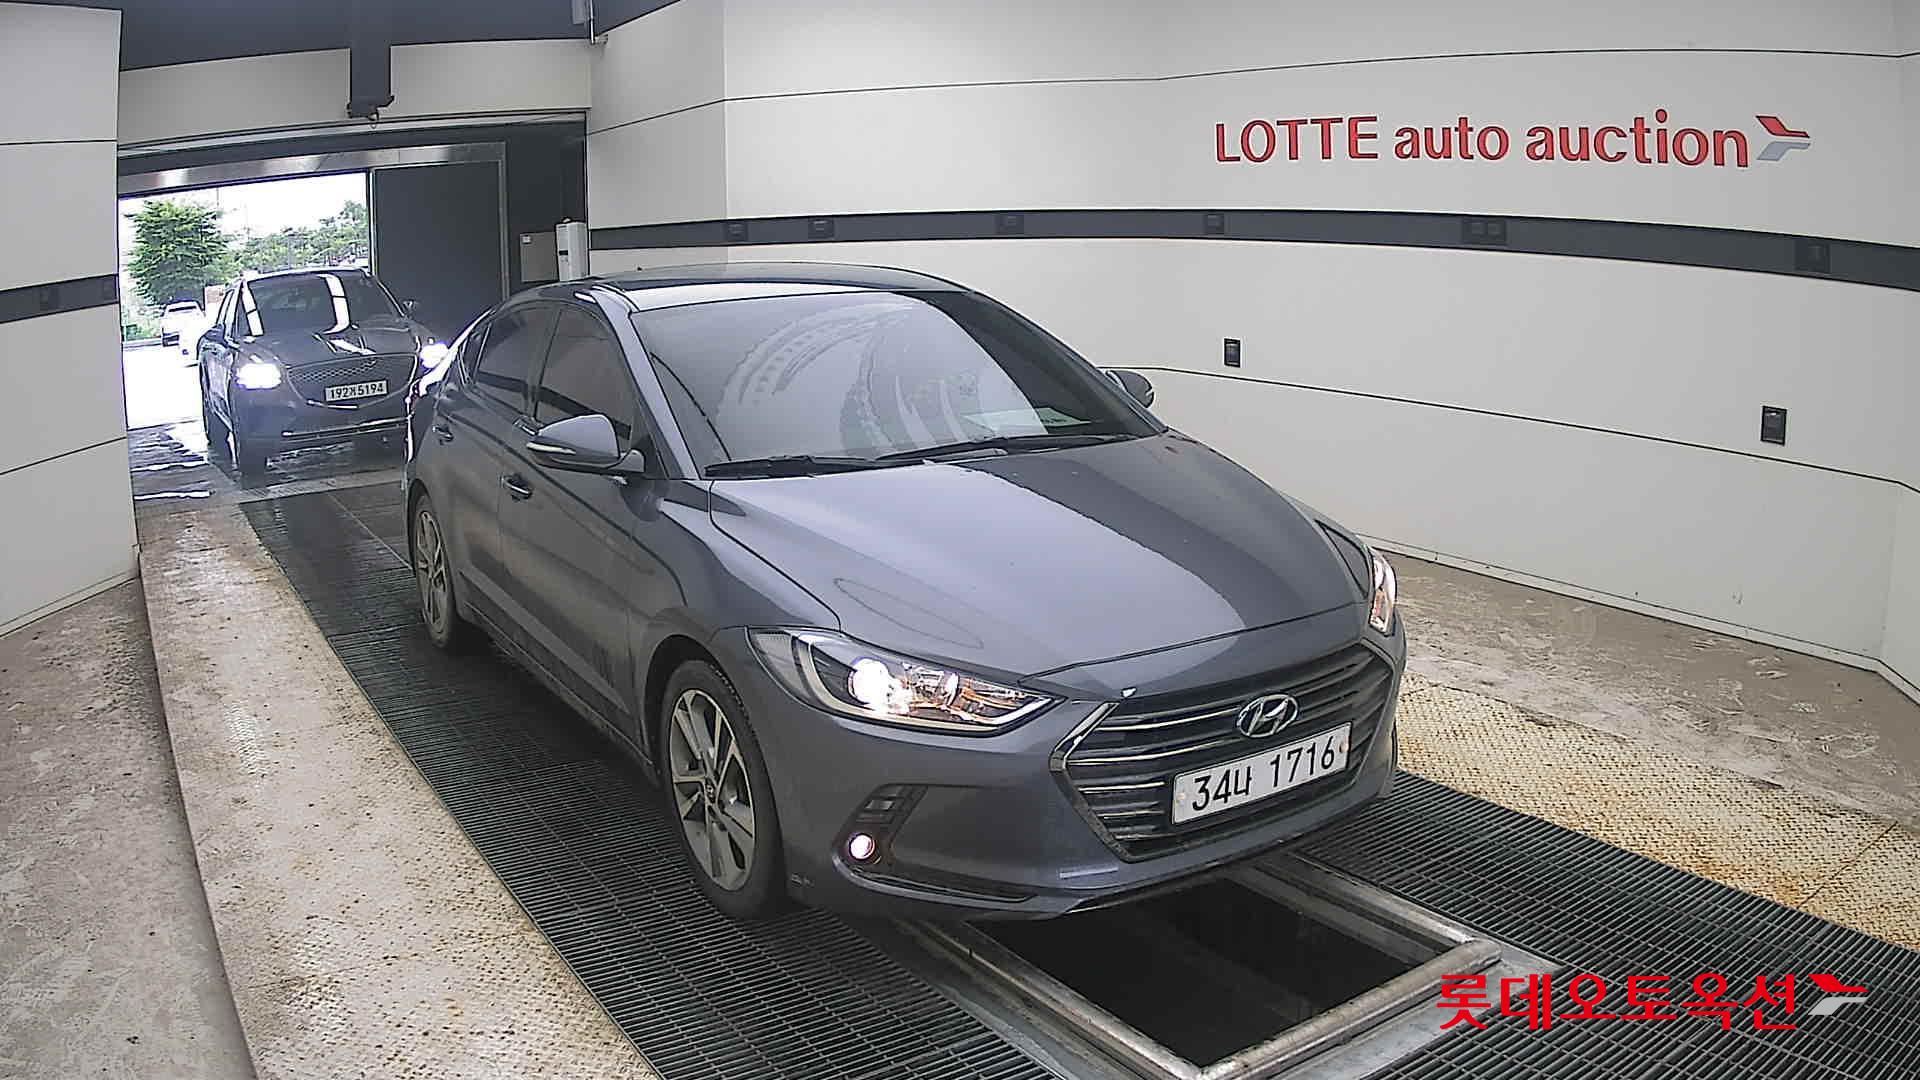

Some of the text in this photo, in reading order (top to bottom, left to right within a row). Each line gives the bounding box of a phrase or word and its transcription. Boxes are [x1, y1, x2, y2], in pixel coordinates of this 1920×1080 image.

[1215, 109, 1750, 167] LOTTE auto auction
[1191, 735, 1336, 812] 34나 1716
